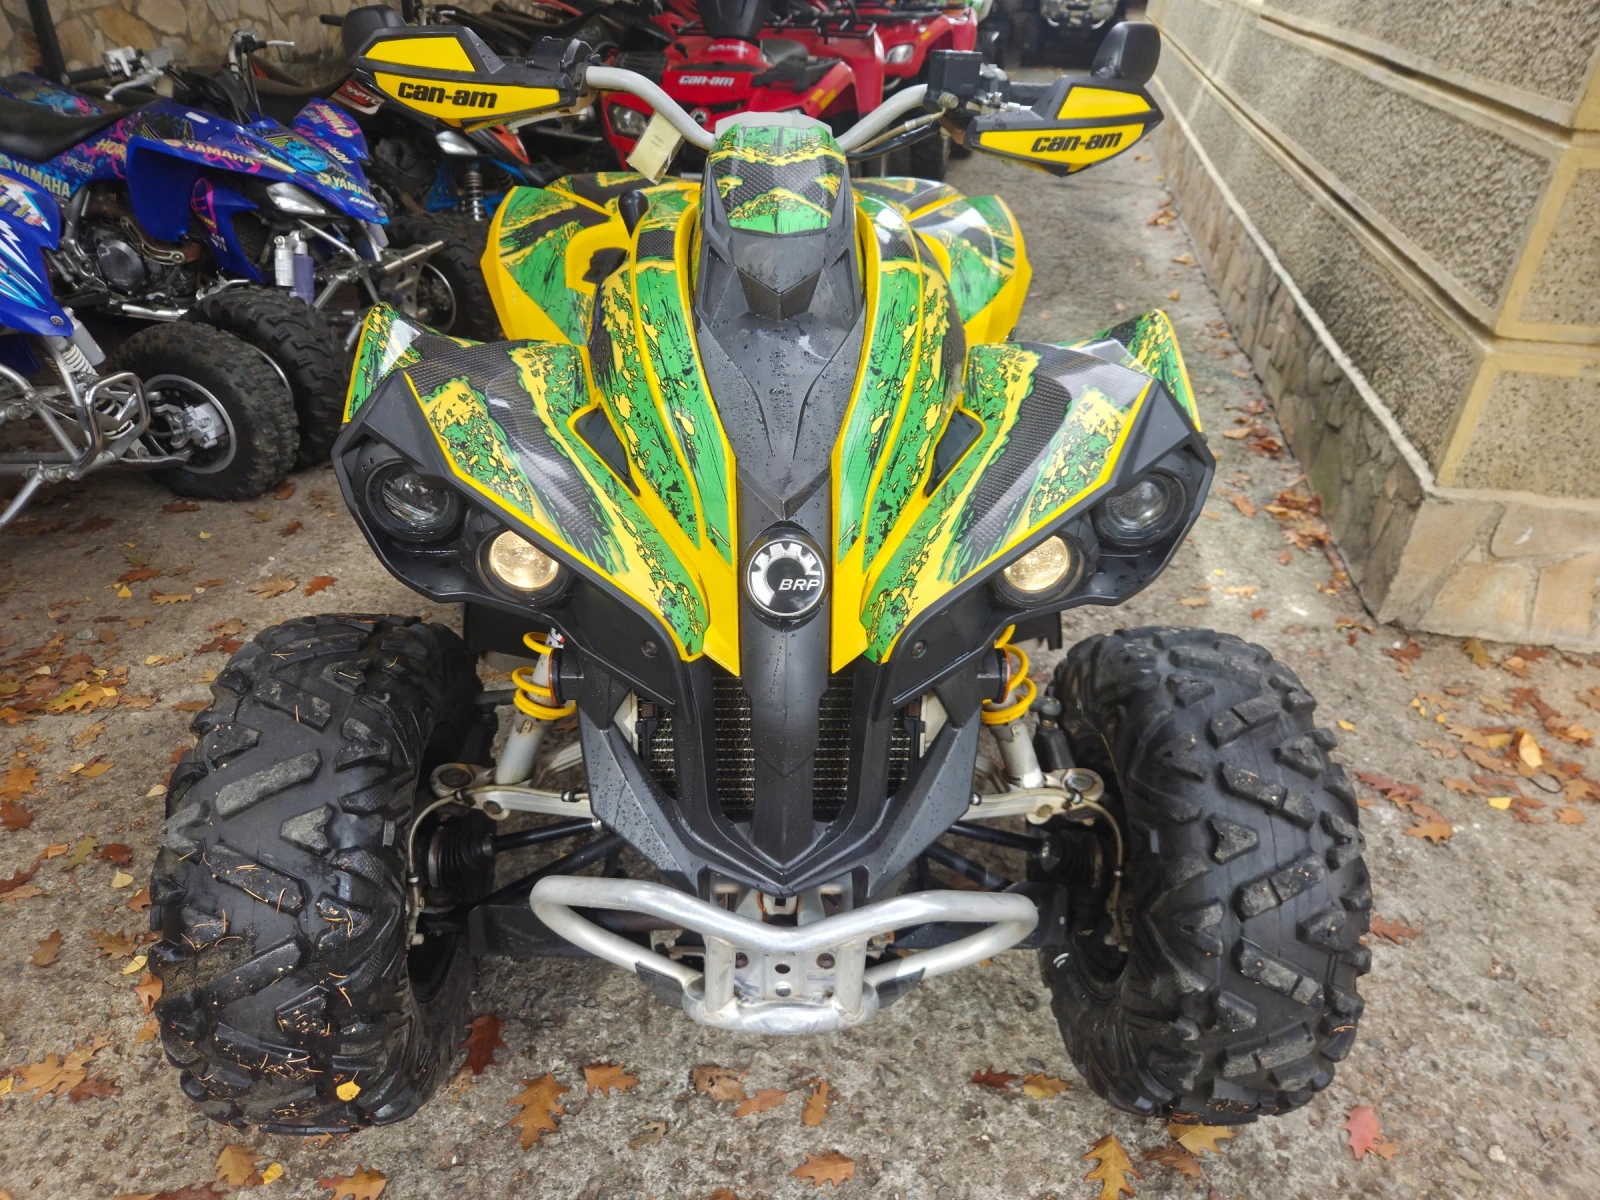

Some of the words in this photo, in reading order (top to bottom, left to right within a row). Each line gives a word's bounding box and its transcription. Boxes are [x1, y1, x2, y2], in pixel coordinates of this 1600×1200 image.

[678, 75, 735, 87] can-am
[346, 85, 383, 107] RAPTO
[398, 82, 498, 109] can-am
[1031, 132, 1123, 153] can-am
[185, 142, 256, 166] YAMAHA
[13, 160, 71, 199] YAMAHA
[779, 579, 821, 591] BRP
